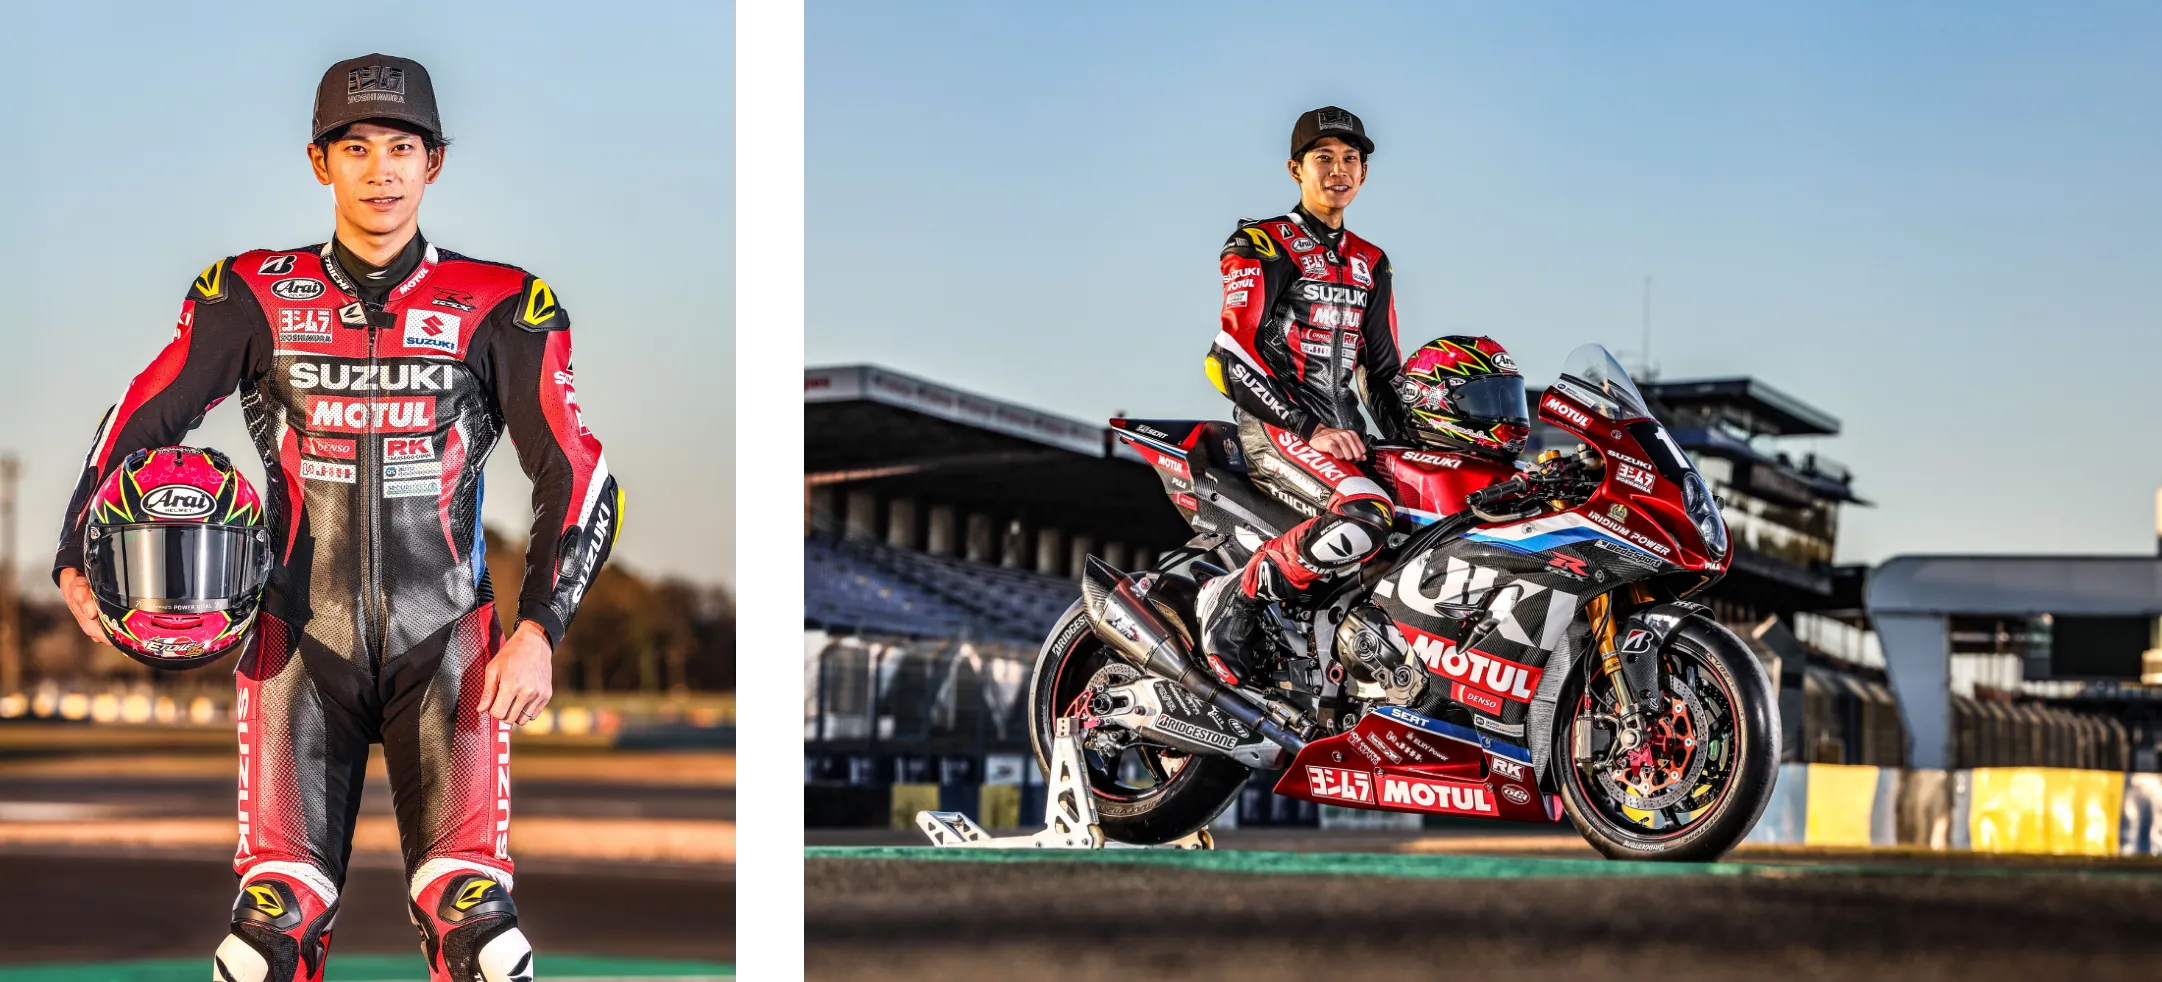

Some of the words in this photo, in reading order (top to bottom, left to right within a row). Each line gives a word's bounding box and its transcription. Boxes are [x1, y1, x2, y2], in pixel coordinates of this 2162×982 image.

[400, 267, 429, 295] MOTUL
[1223, 267, 1260, 283] SUZUKI
[277, 280, 319, 294] Arai
[1303, 284, 1368, 307] SUZUKI
[406, 336, 456, 351] SUZUKI
[1344, 333, 1357, 344] RK
[289, 362, 453, 390] SUZUKI
[1232, 363, 1290, 420] SUZUKI
[312, 401, 430, 429] MOTUL
[1546, 398, 1590, 428] MOTUL
[318, 443, 351, 453] DENSO
[388, 439, 429, 456] RK
[1278, 431, 1348, 482] SUZUKI
[1158, 455, 1184, 473] MOTUL
[1401, 451, 1462, 468] SUZUKI
[1607, 449, 1653, 471] SUZUKI
[1618, 464, 1654, 487] ヨシムラ
[148, 489, 207, 509] Arai
[1587, 510, 1630, 536] IRIDIUM
[1630, 532, 1671, 556] POWER
[572, 502, 611, 604] SUZUKI
[1051, 613, 1086, 657] BRIDGES
[1411, 634, 1532, 699] MOTUL
[1467, 692, 1497, 708] DENSO
[1391, 708, 1430, 727] SERT
[1158, 715, 1236, 748] BRIDGESTONE
[1492, 758, 1523, 777] RK
[494, 720, 512, 860] SUZU
[1310, 768, 1373, 803] ヨシムラ
[1383, 779, 1491, 812] MOTUL
